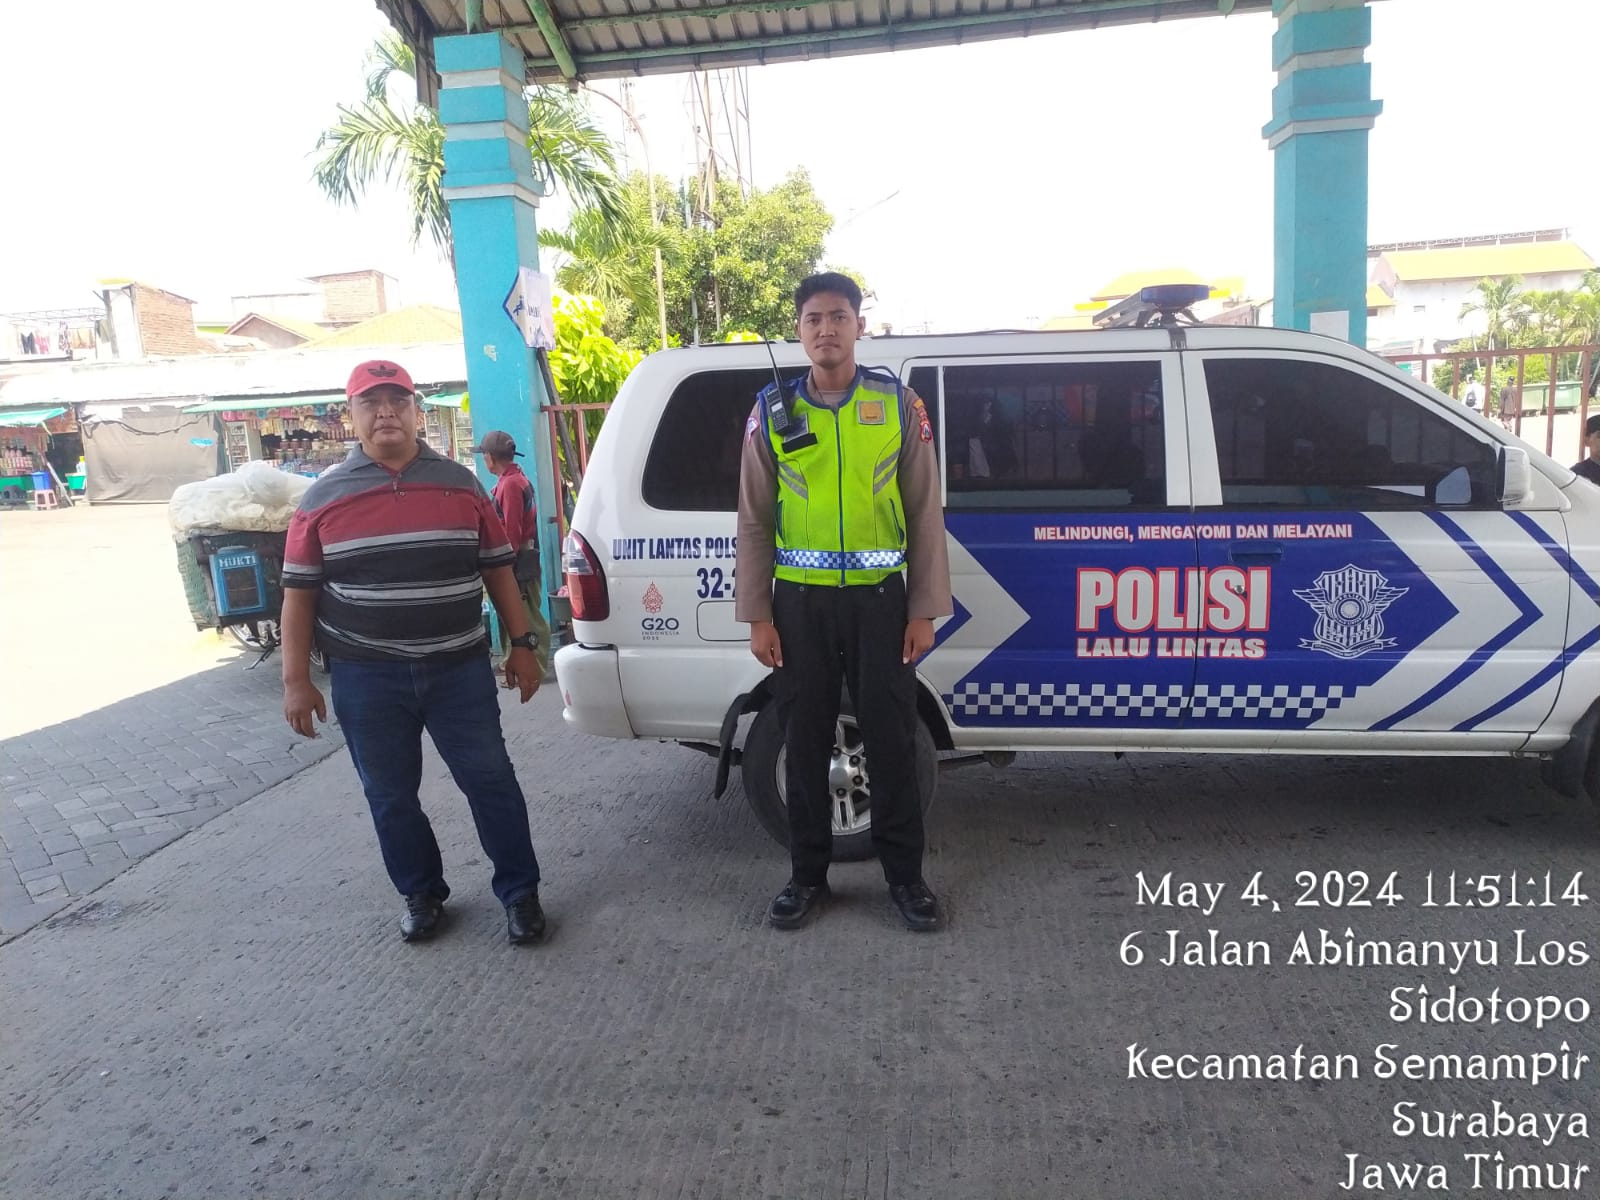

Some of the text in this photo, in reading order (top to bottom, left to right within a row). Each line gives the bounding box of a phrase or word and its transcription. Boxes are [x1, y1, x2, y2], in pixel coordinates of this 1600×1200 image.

[1034, 523, 1353, 542] MELINDUNGI, MENGAYOMI DAN MELAYANI
[612, 538, 645, 560] UNIT
[649, 538, 701, 559] LANTAS
[218, 555, 256, 567] MUKTI
[1076, 566, 1271, 632] POLISI
[1076, 638, 1266, 658] LALU LINTAS
